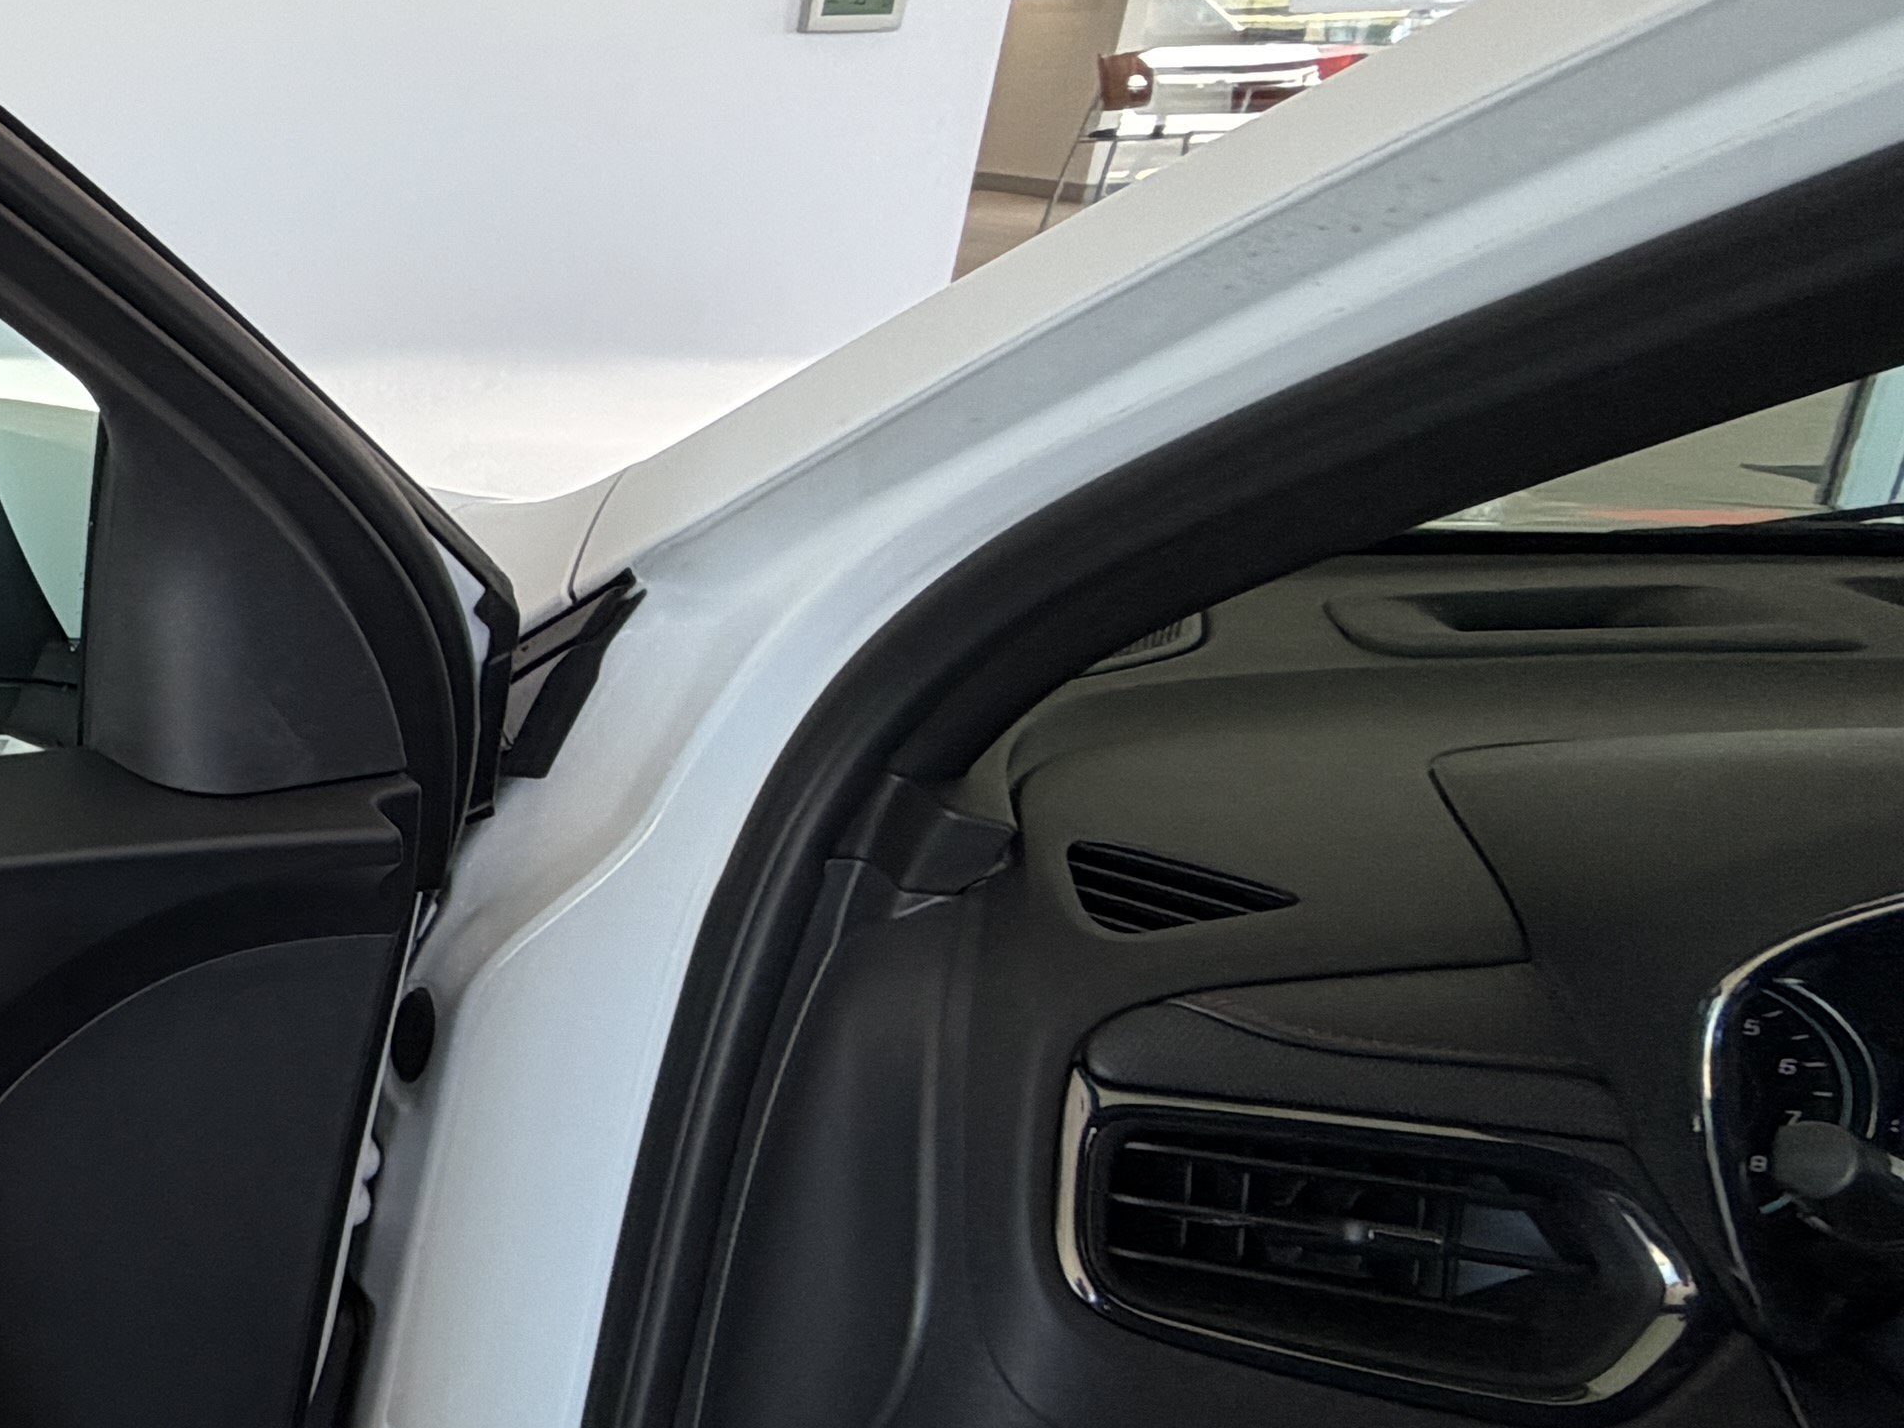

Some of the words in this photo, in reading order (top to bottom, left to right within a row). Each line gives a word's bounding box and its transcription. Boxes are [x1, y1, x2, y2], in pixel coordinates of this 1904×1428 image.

[1743, 1018, 1761, 1036] 5
[1778, 1058, 1798, 1075] 6
[1749, 1154, 1768, 1172] 8
